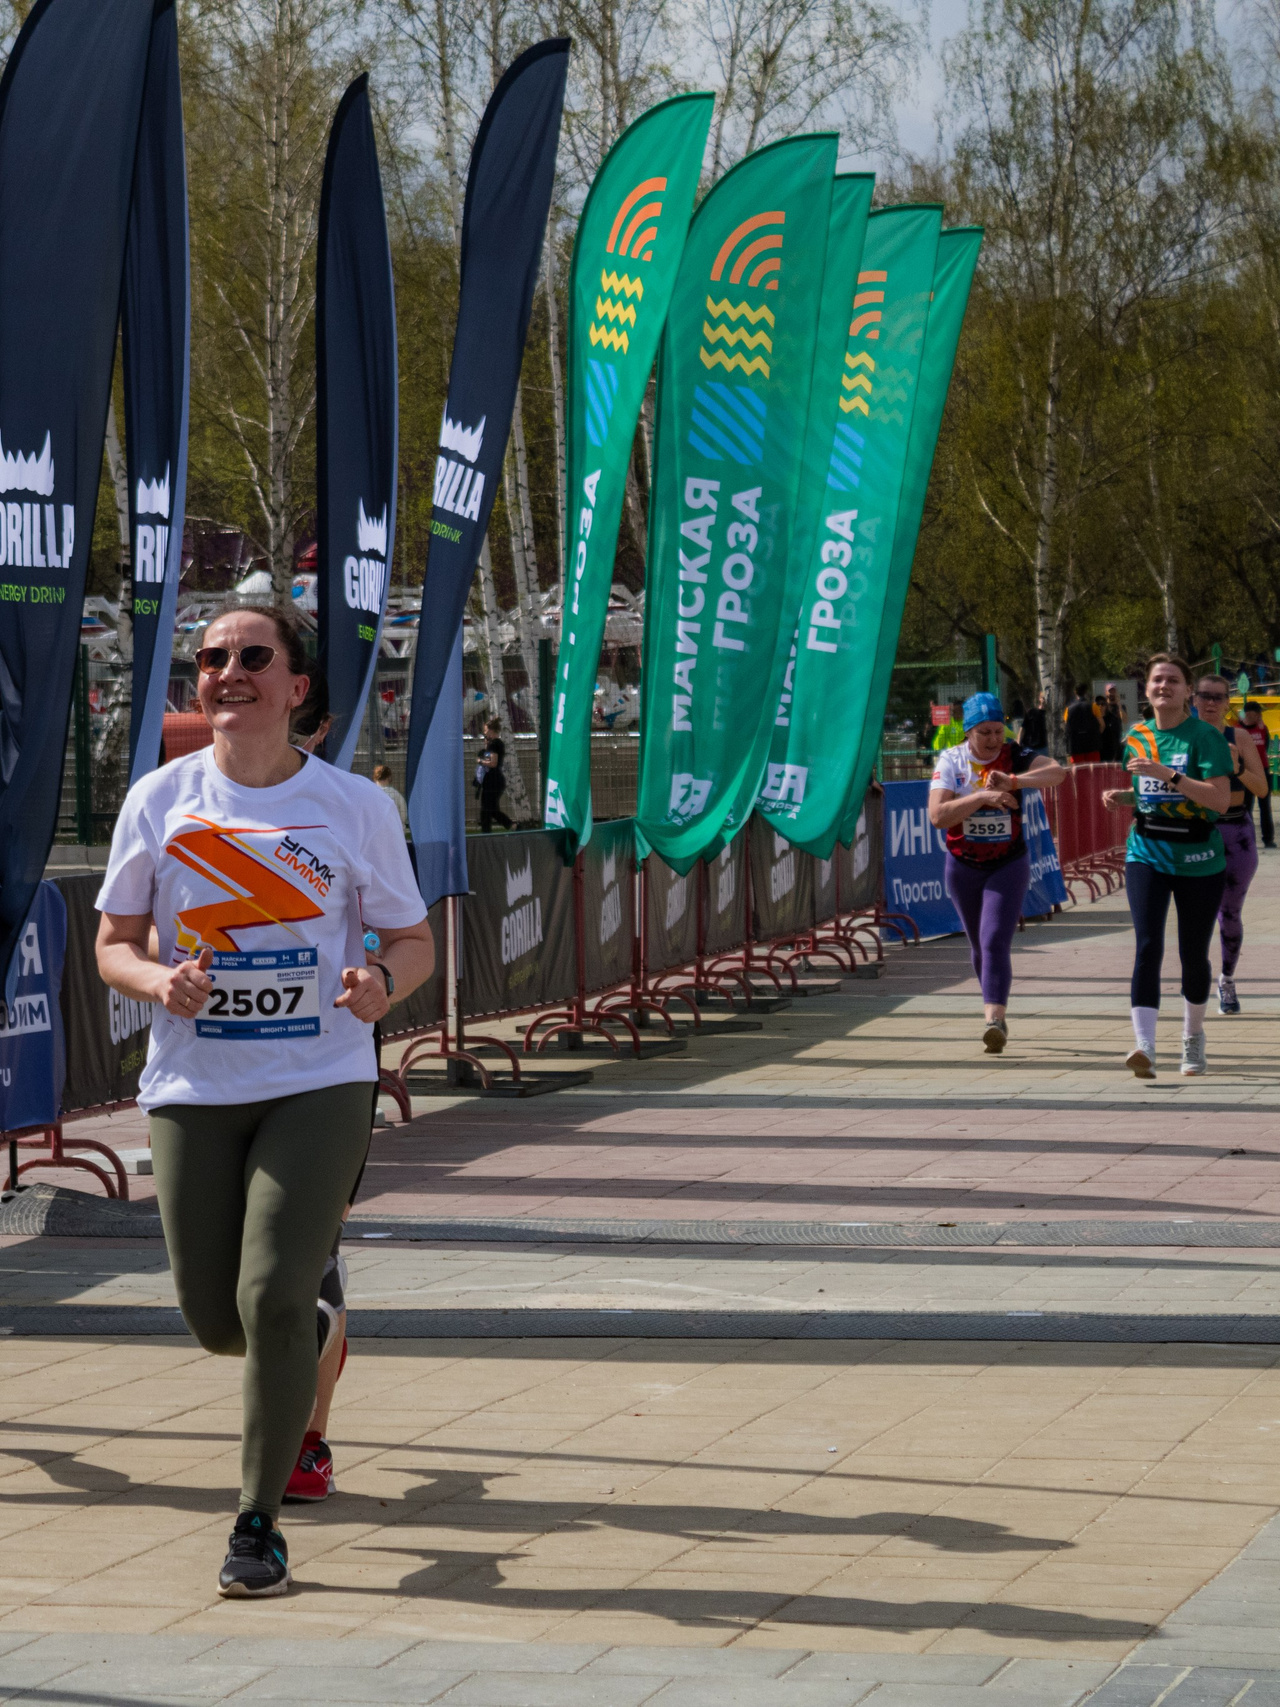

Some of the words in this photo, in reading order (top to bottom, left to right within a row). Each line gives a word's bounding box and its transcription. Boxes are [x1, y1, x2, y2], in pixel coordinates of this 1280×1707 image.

[712, 486, 763, 653] ГРОЗА
[806, 509, 858, 654] ГРОЗА
[969, 823, 1005, 835] 2592
[274, 845, 331, 898] UMMC
[280, 835, 336, 888] УГМК
[1184, 849, 1215, 864] 2023
[892, 879, 942, 911] Просто
[501, 897, 544, 966] GORILLA
[277, 970, 316, 978] ВИКТОРИЯ
[208, 986, 304, 1017] 2507
